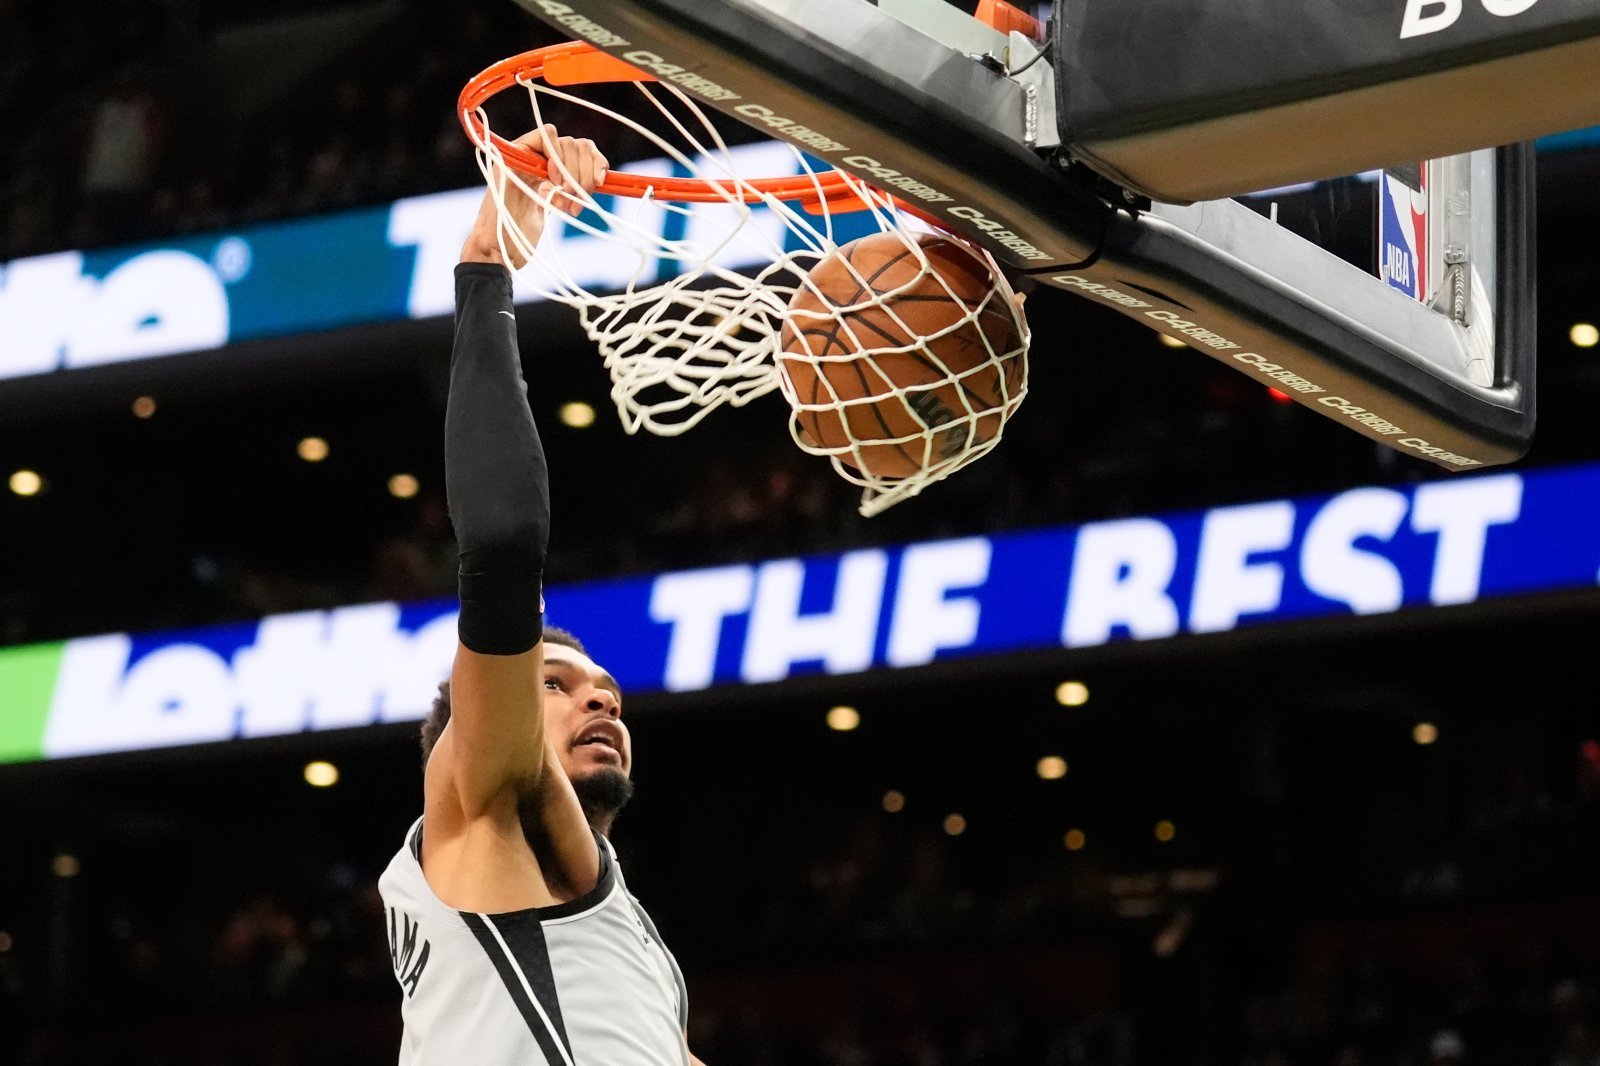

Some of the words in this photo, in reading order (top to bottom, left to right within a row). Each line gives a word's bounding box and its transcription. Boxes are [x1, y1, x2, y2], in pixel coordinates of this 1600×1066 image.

[534, 0, 575, 16] 4
[1387, 242, 1410, 288] NBA
[1061, 473, 1524, 648] BEST
